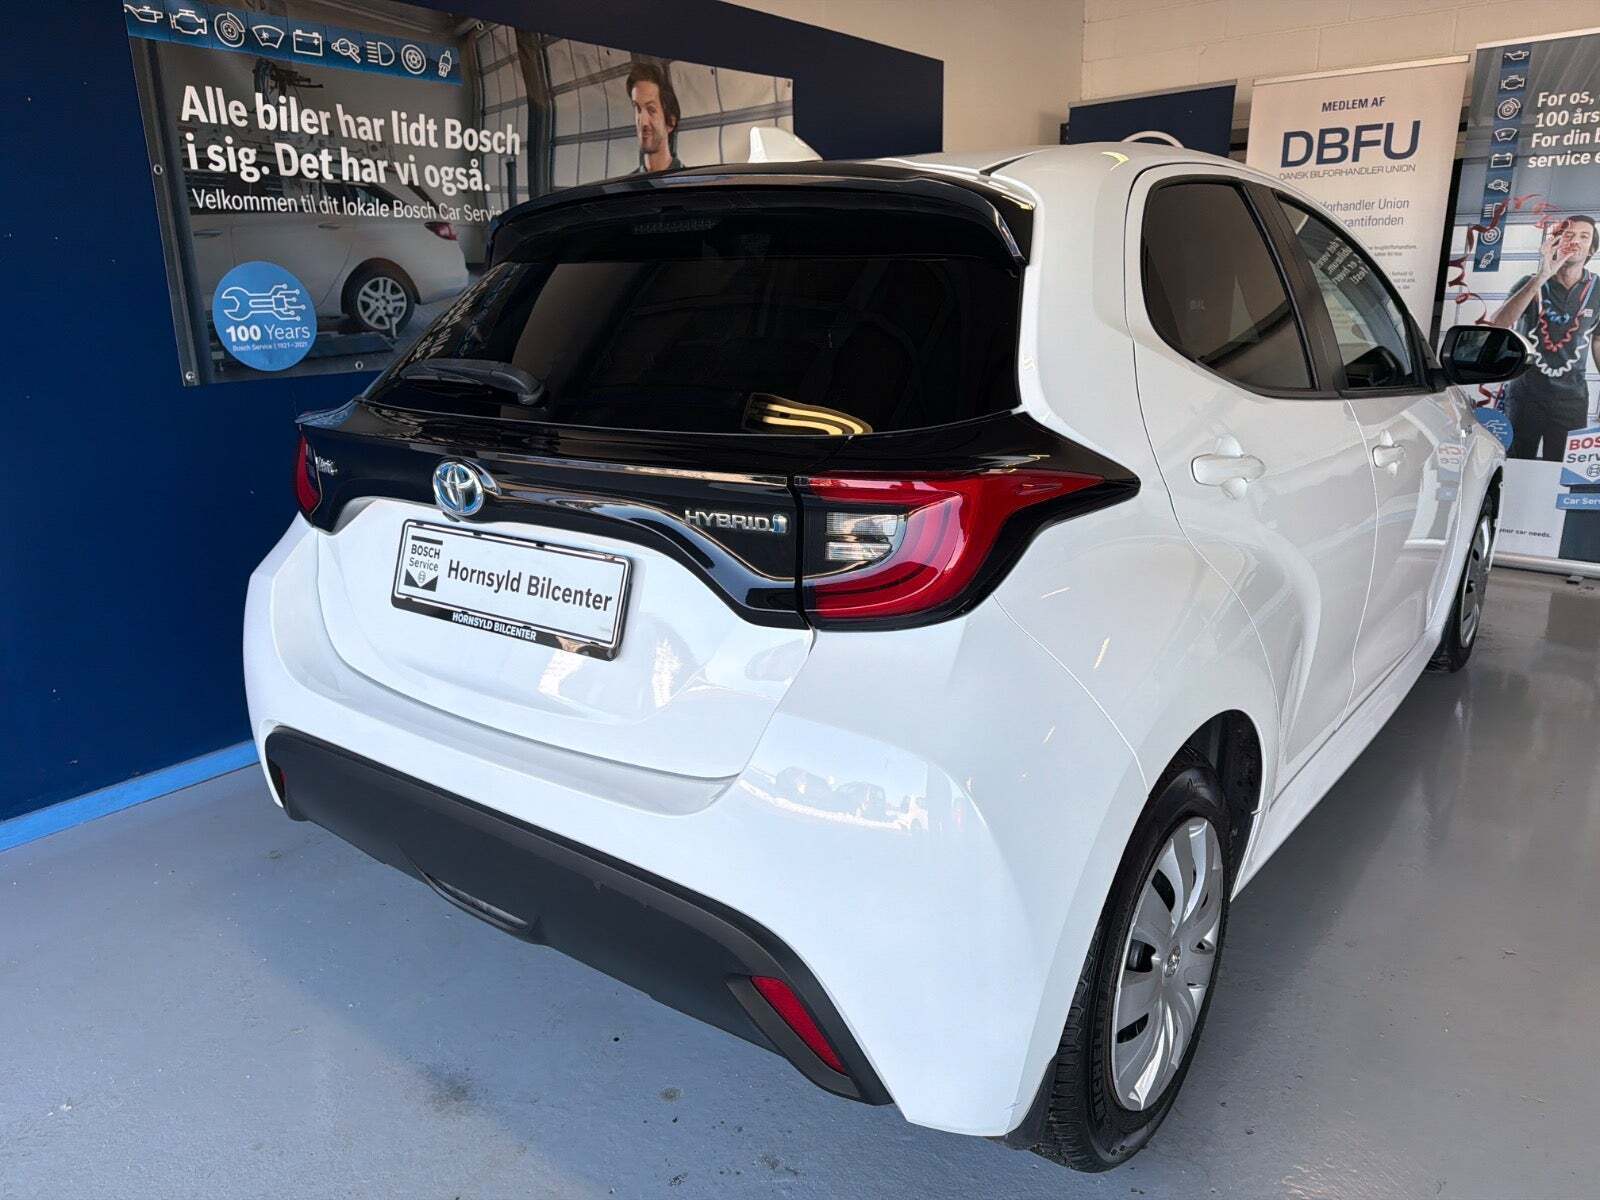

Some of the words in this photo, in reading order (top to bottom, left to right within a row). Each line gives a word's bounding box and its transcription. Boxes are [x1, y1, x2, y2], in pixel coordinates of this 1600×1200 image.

[1321, 98, 1368, 112] MEDLEM
[1371, 96, 1386, 107] AF
[1537, 92, 1567, 107] For
[1570, 91, 1595, 105] os,
[181, 85, 248, 127] Alle
[256, 93, 331, 136] biler
[336, 104, 384, 142] har
[392, 110, 438, 149] lidt
[444, 118, 521, 156] Bosch
[1535, 111, 1569, 128] 100
[1572, 108, 1600, 125] års
[1280, 120, 1421, 168] DBFU
[1531, 133, 1560, 148] For
[1563, 130, 1591, 145] din
[186, 133, 198, 170] i
[208, 136, 270, 183] sig.
[275, 142, 333, 181] Det
[341, 146, 388, 184] har
[394, 154, 419, 187] vi
[424, 158, 491, 196] også.
[1528, 150, 1591, 168] service
[1279, 172, 1308, 181] DANSK
[1310, 166, 1384, 178] BILFORHANDLER
[1385, 163, 1416, 174] UNION
[192, 189, 298, 213] Velkommen
[301, 194, 317, 215] til
[319, 195, 340, 216] dit
[343, 197, 390, 219] lokale
[394, 200, 437, 221] Bosch
[439, 203, 460, 220] Car
[1378, 198, 1410, 209] Union
[1344, 215, 1404, 227] rantifonden
[226, 325, 261, 342] 100
[264, 324, 311, 340] Years
[1569, 436, 1600, 451] BOS
[1566, 452, 1600, 463] Serv
[1563, 497, 1580, 505] Car
[684, 510, 771, 532] HYBRID
[411, 543, 441, 559] BOSCH
[409, 556, 439, 571] Service
[447, 559, 522, 593] Hornsyld
[527, 575, 612, 612] Bilcenter
[452, 611, 493, 631] HORNSYLD
[493, 621, 537, 641] BILCENTER
